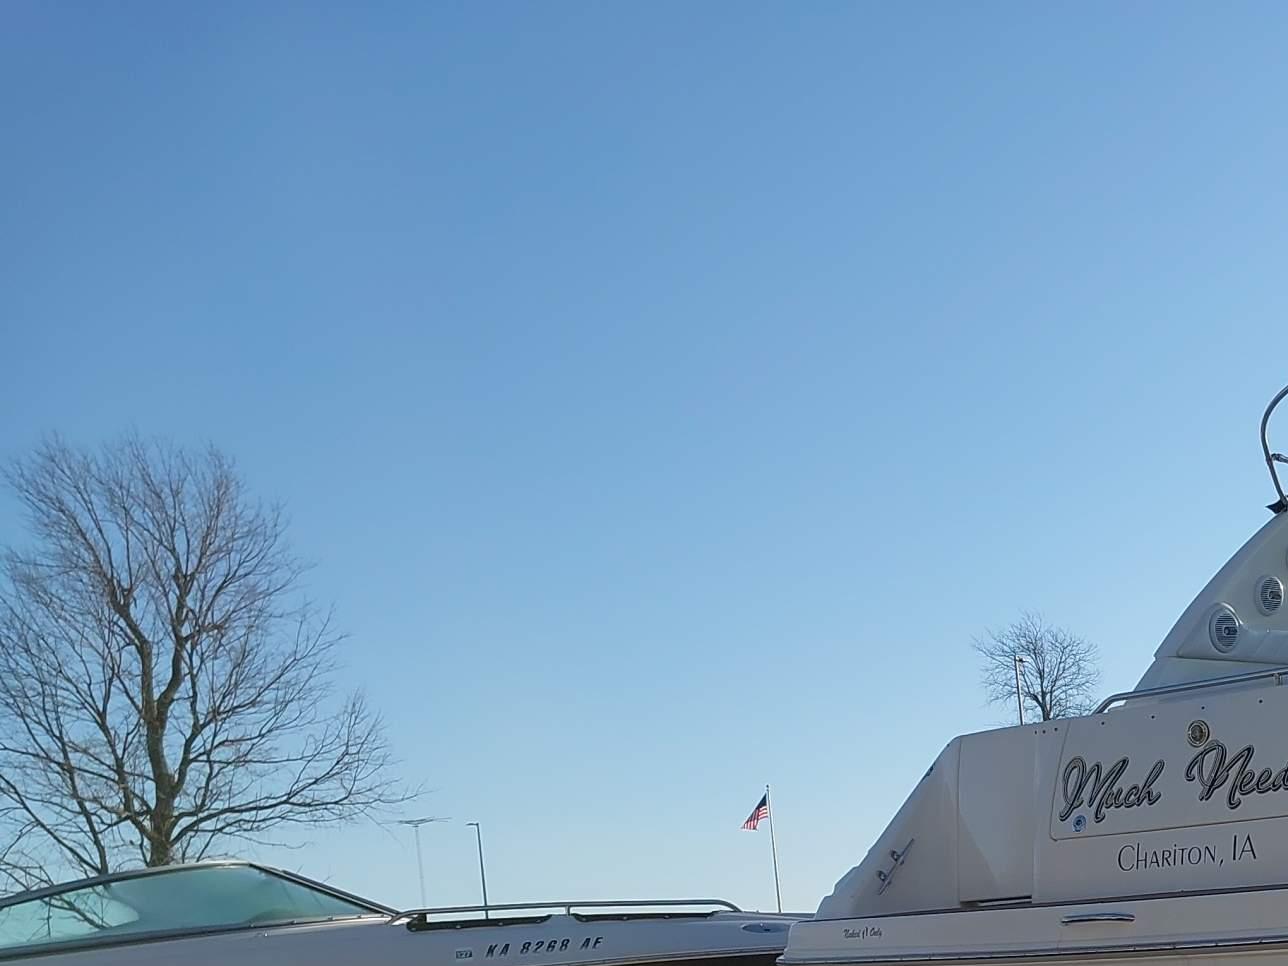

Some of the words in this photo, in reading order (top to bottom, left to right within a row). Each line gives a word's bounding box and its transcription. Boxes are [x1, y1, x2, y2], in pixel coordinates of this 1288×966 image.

[1060, 756, 1165, 823] Much
[1232, 833, 1257, 861] IA
[485, 943, 511, 958] KA
[520, 938, 570, 955] 8268
